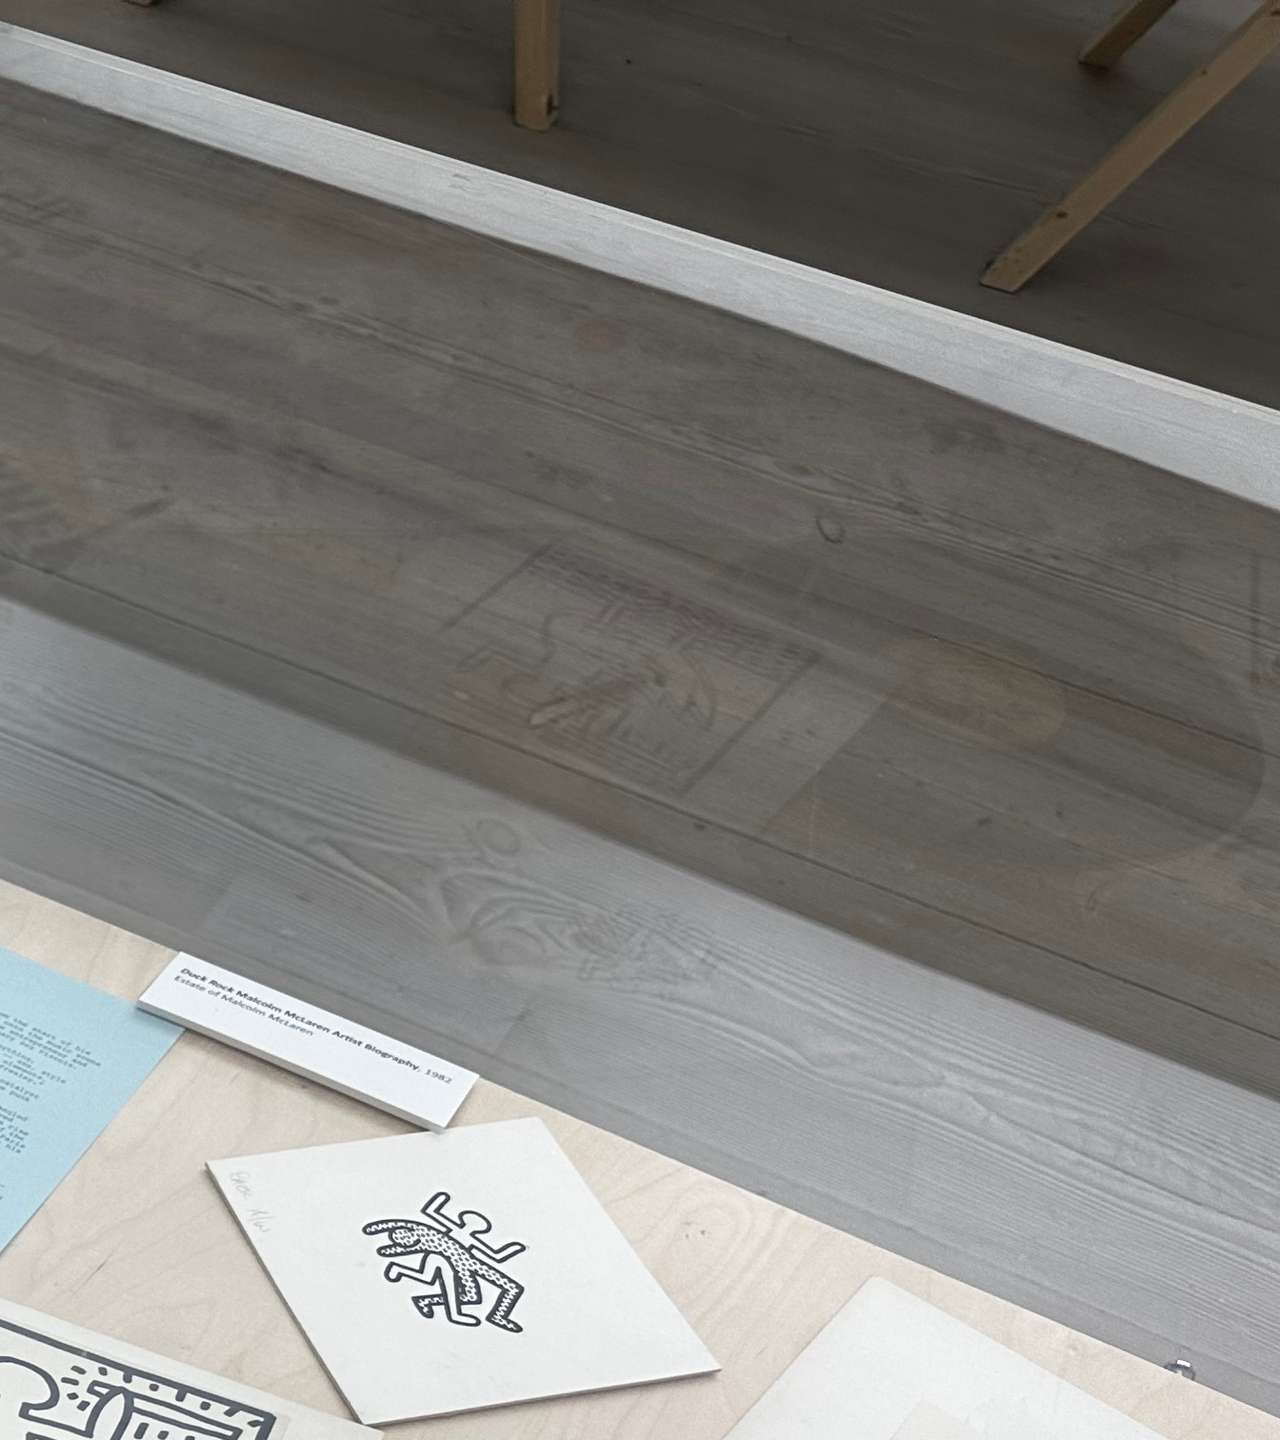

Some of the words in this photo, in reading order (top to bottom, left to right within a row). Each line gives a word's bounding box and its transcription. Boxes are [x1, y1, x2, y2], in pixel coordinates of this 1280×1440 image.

[173, 975, 206, 991] Estate
[207, 989, 221, 997] of
[220, 994, 265, 1016] Malcolm
[267, 1013, 313, 1035] McLaren
[180, 967, 207, 982] Duck
[208, 979, 234, 993] Rock
[235, 990, 282, 1012] Malcolm
[283, 1010, 330, 1032] McLaren
[331, 1030, 362, 1046] Artist
